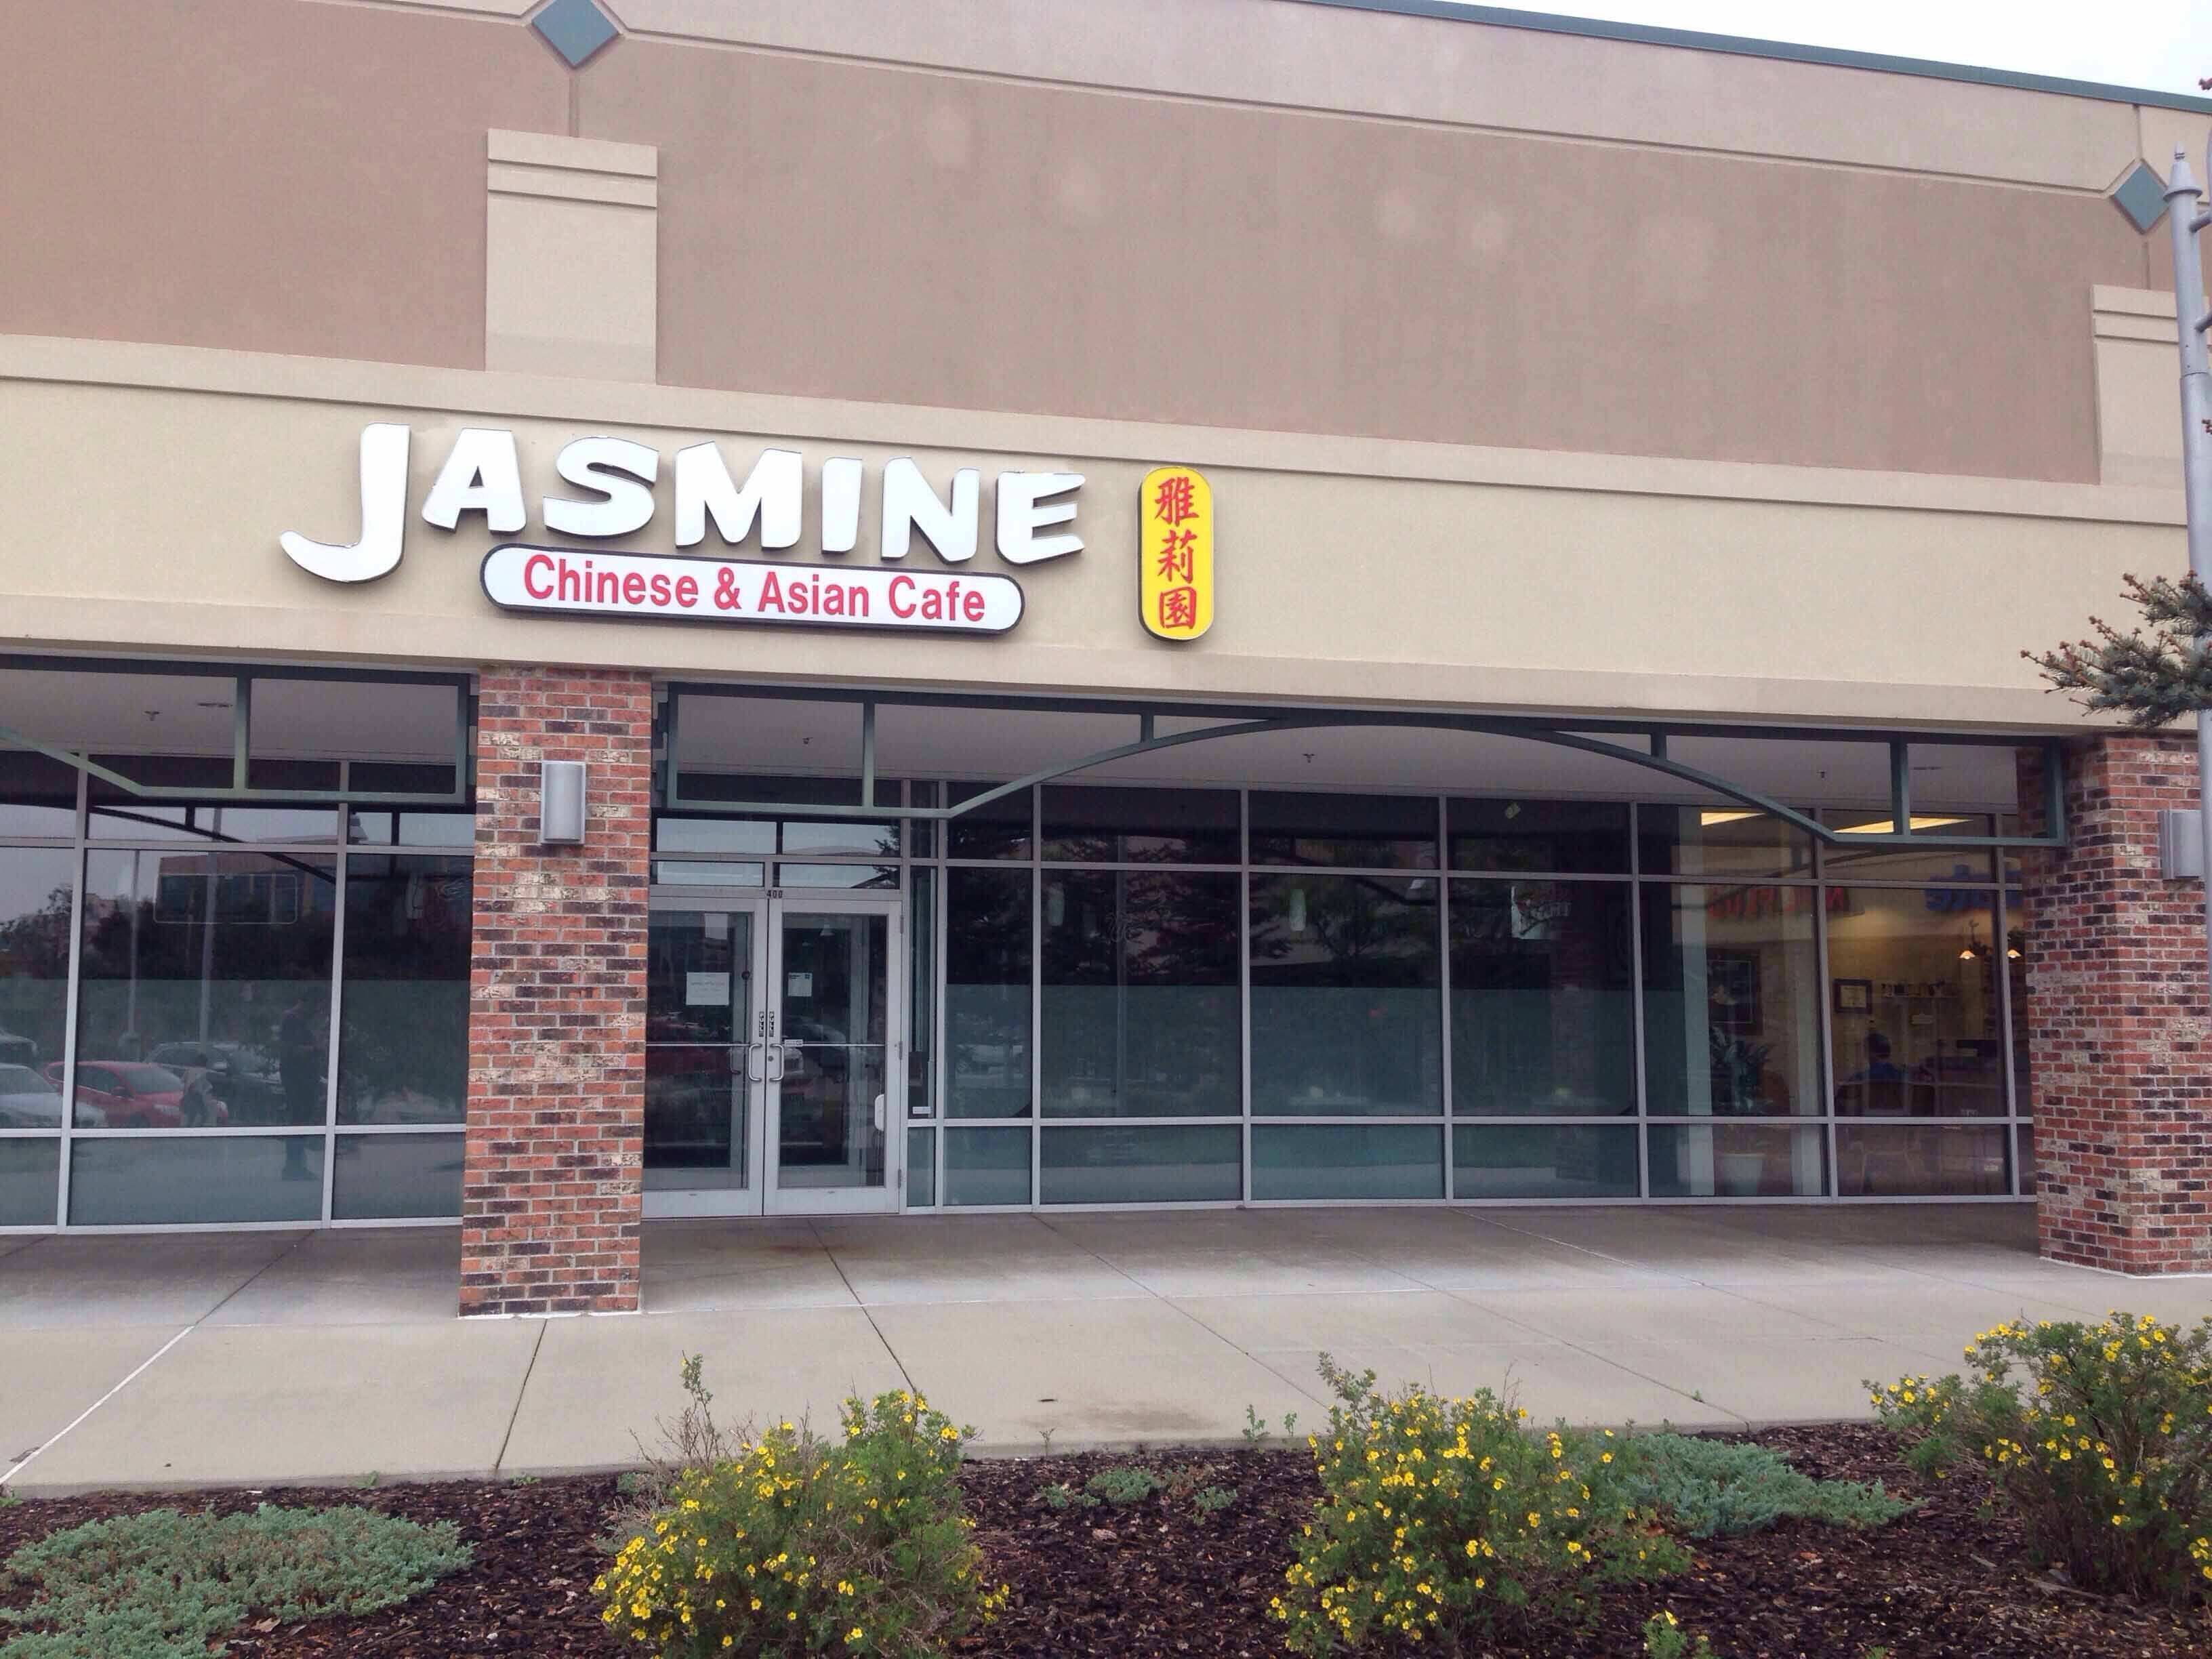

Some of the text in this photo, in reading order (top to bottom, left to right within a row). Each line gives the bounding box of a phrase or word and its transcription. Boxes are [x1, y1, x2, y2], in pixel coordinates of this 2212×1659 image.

[279, 422, 1086, 582] JASMINE
[1154, 476, 1200, 630] 雅莉園
[523, 554, 986, 622] Chinese & Asian Cafe
[766, 890, 783, 899] 400
